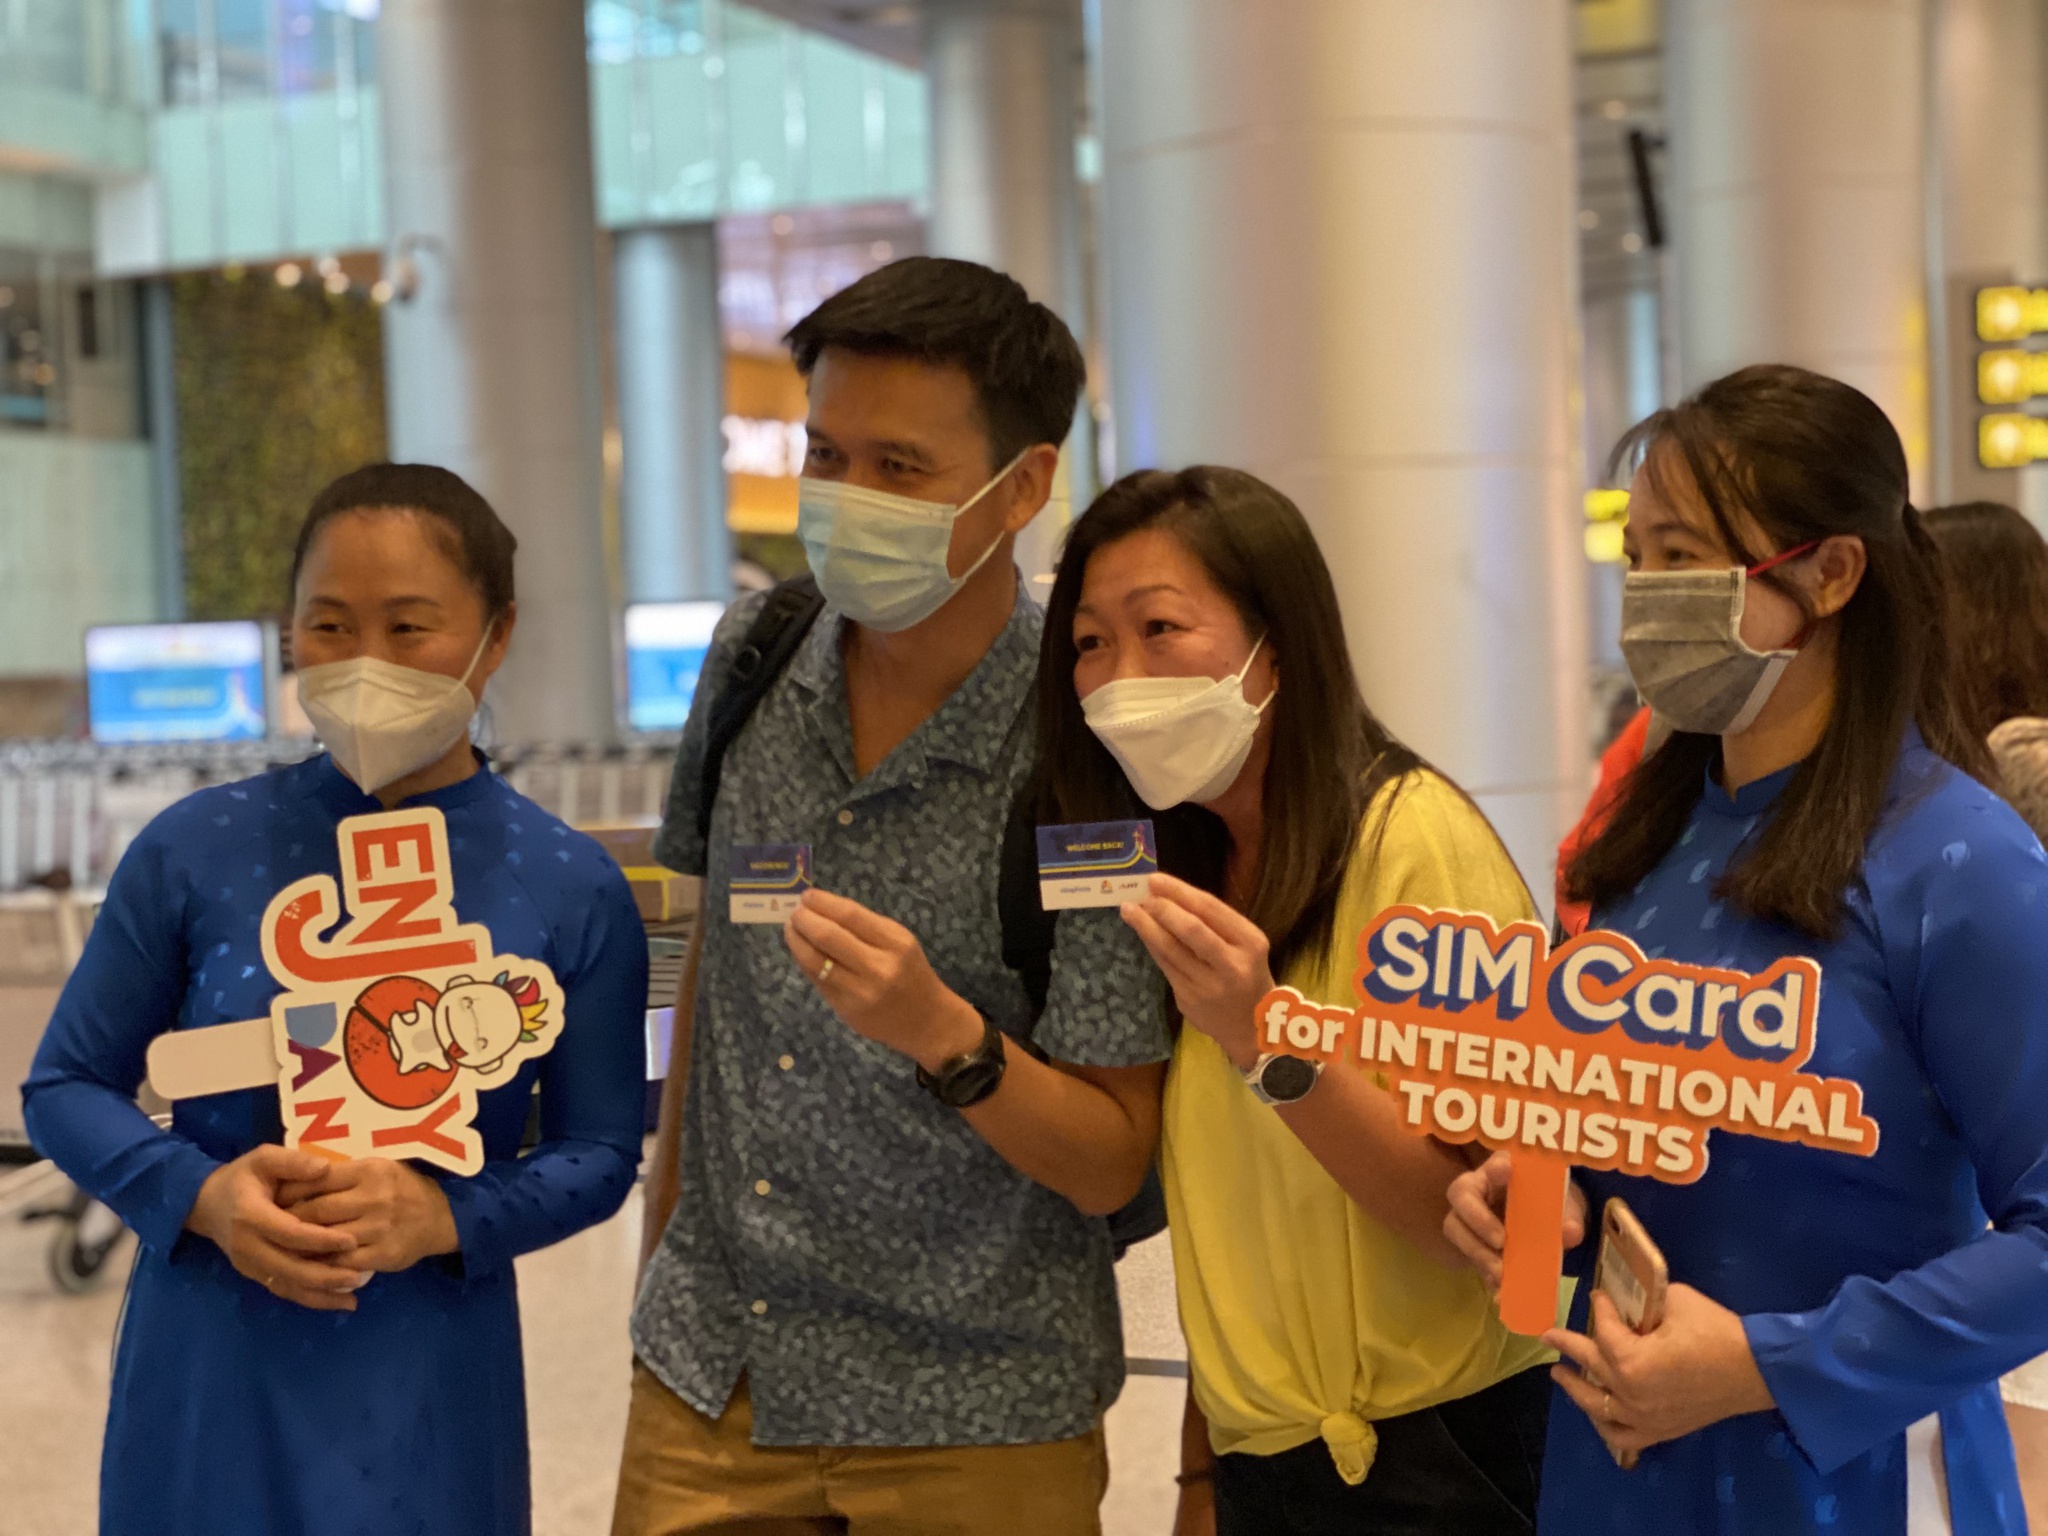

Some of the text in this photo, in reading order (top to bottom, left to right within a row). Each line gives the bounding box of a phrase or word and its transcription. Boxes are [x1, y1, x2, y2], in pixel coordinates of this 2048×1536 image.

[274, 822, 478, 1162] ENJOY
[1376, 916, 1805, 1051] SIM Card
[1265, 1001, 1865, 1143] for INTERNATIONAL
[1399, 1080, 1695, 1174] TOURISTS
